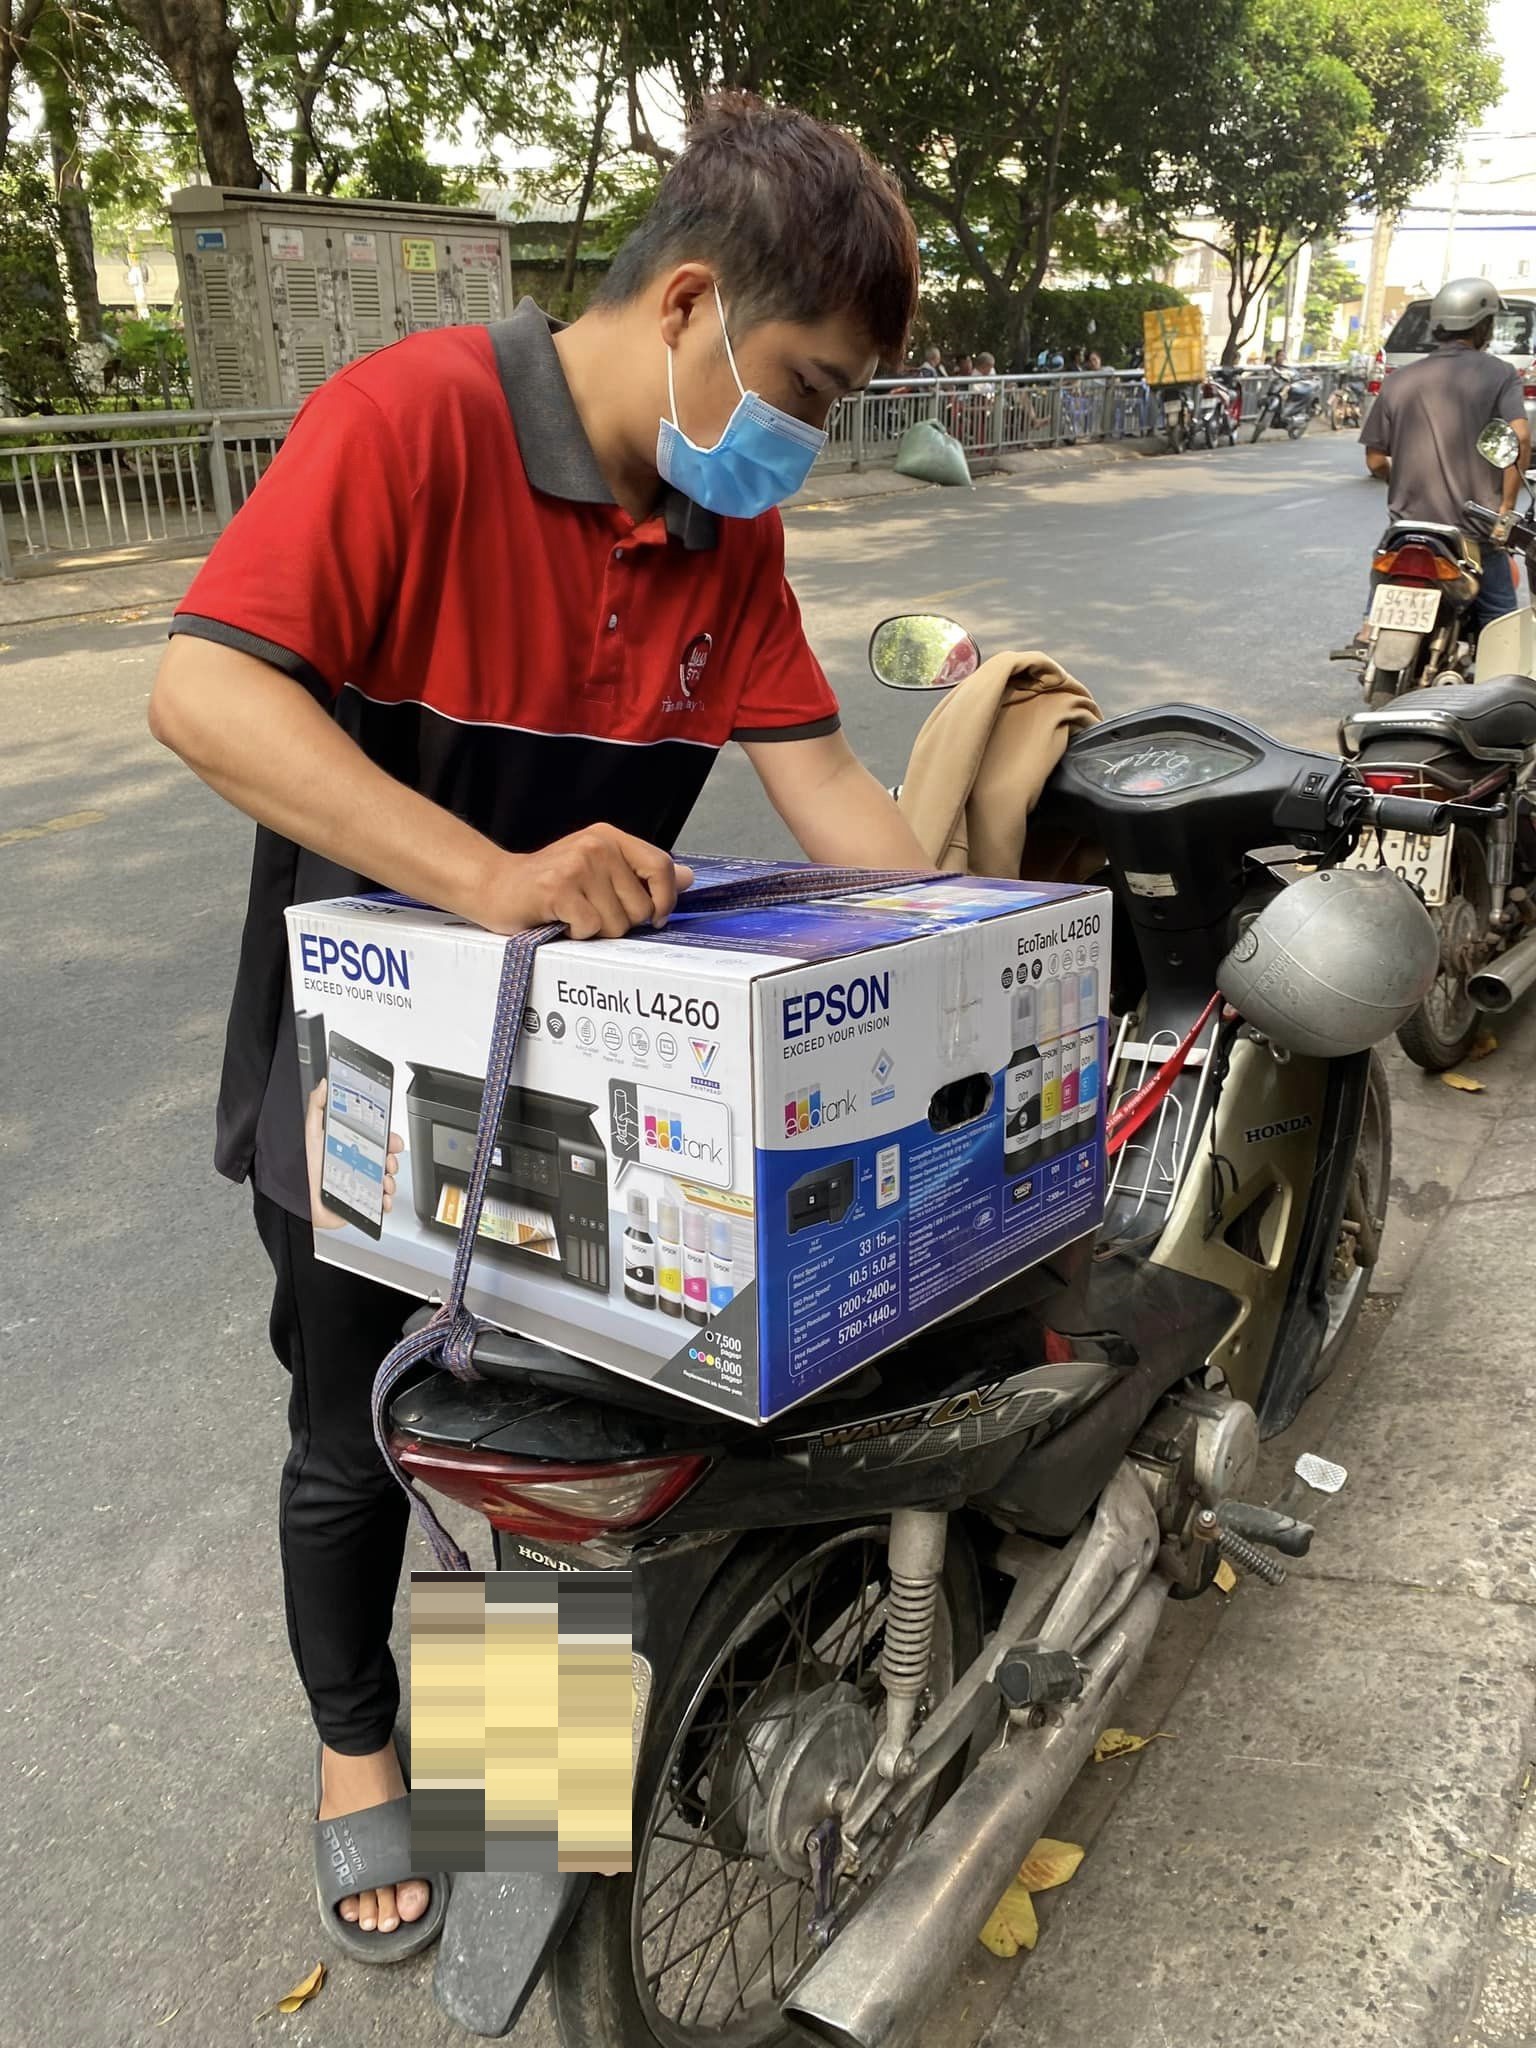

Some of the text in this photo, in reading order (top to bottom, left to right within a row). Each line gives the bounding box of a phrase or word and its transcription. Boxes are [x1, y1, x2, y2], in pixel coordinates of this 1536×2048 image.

[1017, 914, 1101, 956] EcoTank L4260
[300, 932, 410, 991] EPSON
[304, 977, 413, 1009] EXCEED YOUR VISION
[557, 980, 720, 1031] EcoTank L4260
[783, 971, 889, 1041] EPSON
[783, 1015, 890, 1060] EXCEED YOUR VISION
[1015, 1069, 1033, 1082] EPSON
[1245, 1115, 1313, 1144] HONDA
[859, 1239, 871, 1257] 33
[876, 1231, 887, 1249] 15
[848, 1265, 868, 1288] 10.5
[872, 1256, 887, 1276] 5.0
[715, 1332, 741, 1352] 7,500
[715, 1357, 742, 1377] 6,000
[823, 1411, 923, 1448] WAVE
[322, 1823, 356, 1888] SPORT
